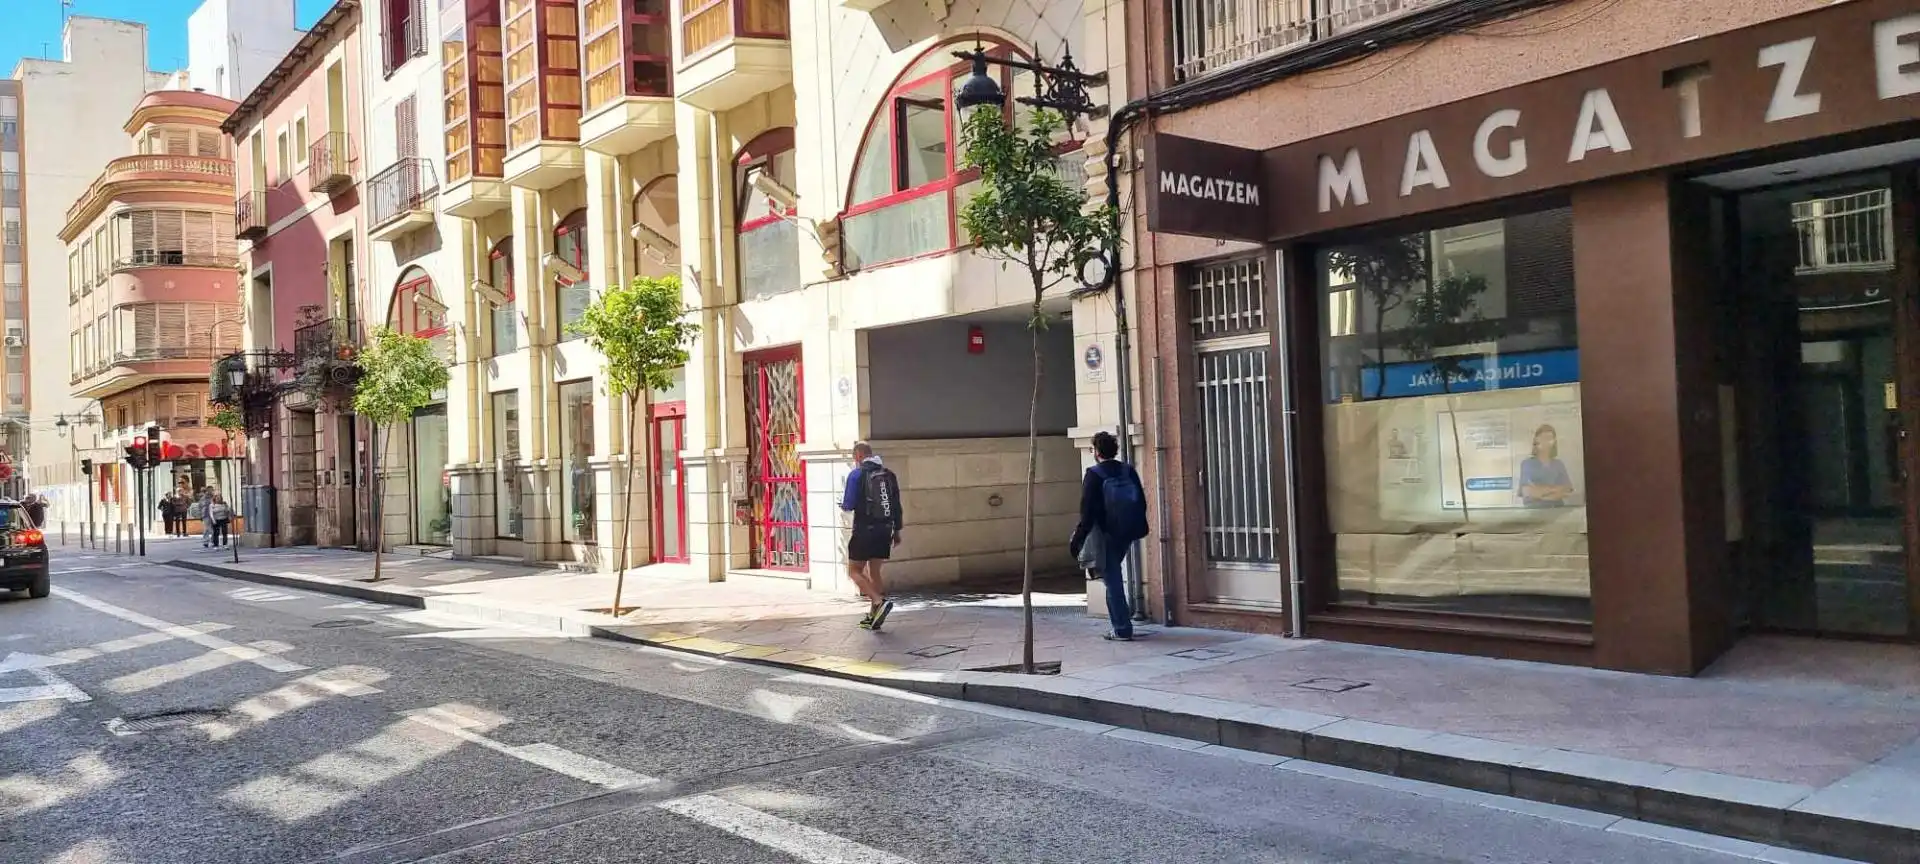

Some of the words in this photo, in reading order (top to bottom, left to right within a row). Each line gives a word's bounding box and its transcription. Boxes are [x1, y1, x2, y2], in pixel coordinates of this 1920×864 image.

[1317, 12, 1920, 213] MAGATZE
[1160, 170, 1260, 206] MAGATZEM
[880, 481, 891, 517] adidas
